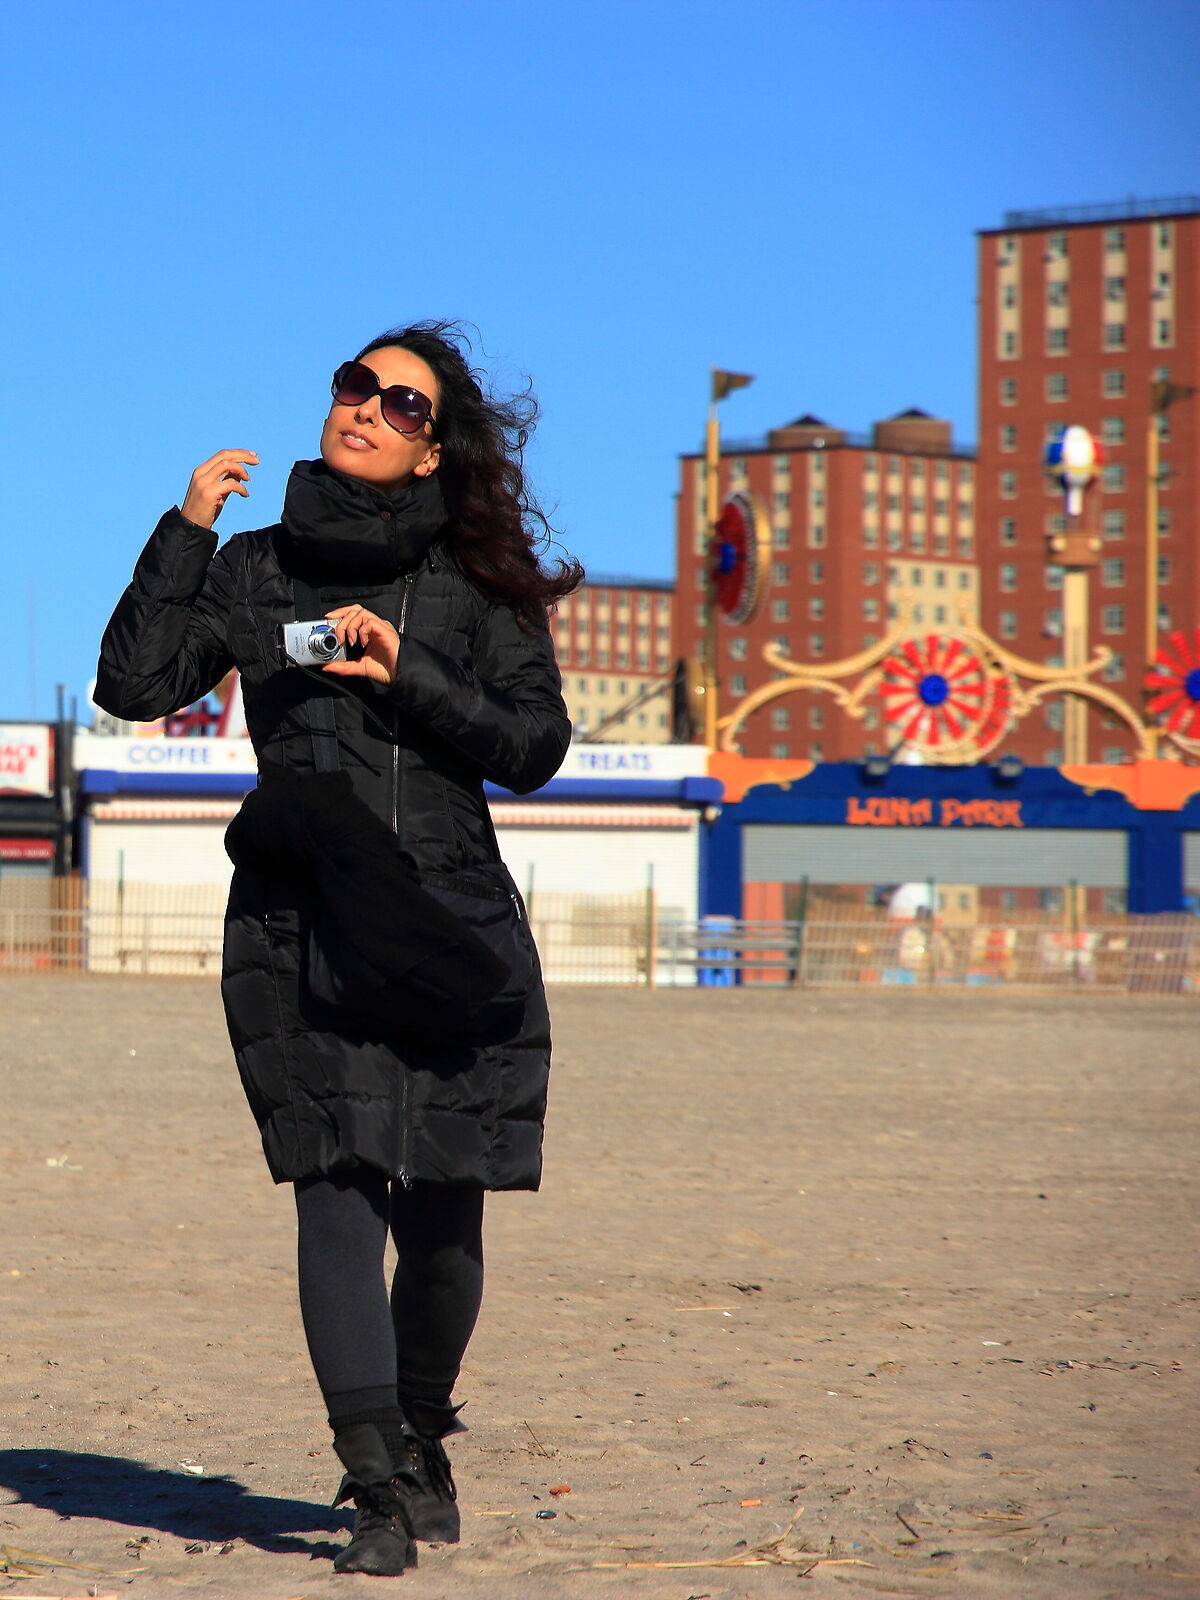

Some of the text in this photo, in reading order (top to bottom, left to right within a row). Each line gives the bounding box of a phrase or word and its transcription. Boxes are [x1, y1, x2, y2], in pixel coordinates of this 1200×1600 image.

[128, 745, 652, 771] COFFEE TREATS
[845, 796, 1024, 828] LUNA PARK
